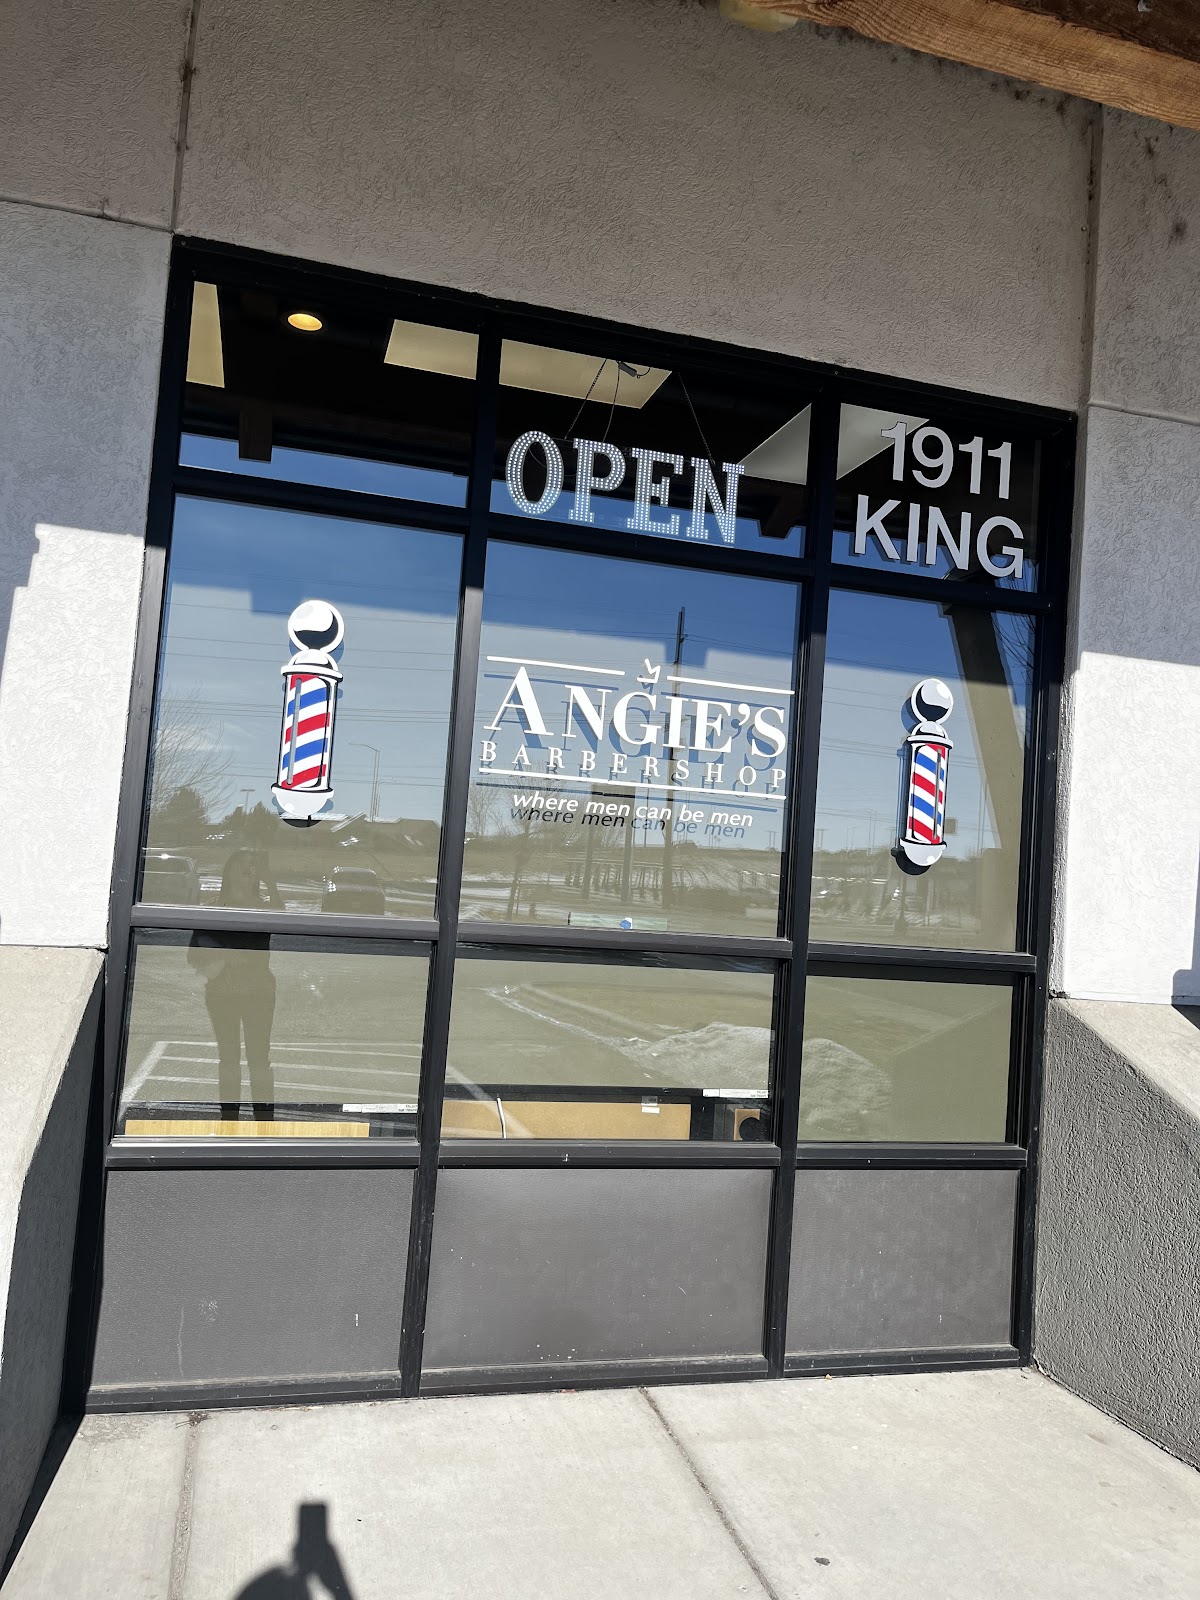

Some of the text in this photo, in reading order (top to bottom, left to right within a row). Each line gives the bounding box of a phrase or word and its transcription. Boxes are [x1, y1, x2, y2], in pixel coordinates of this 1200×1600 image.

[505, 430, 745, 544] OPEN
[881, 421, 1012, 499] 1911
[854, 494, 1024, 578] KING
[483, 666, 787, 758] ANGIE'S
[479, 740, 786, 788] BARBERSHOP
[512, 792, 754, 826] where men can be men
